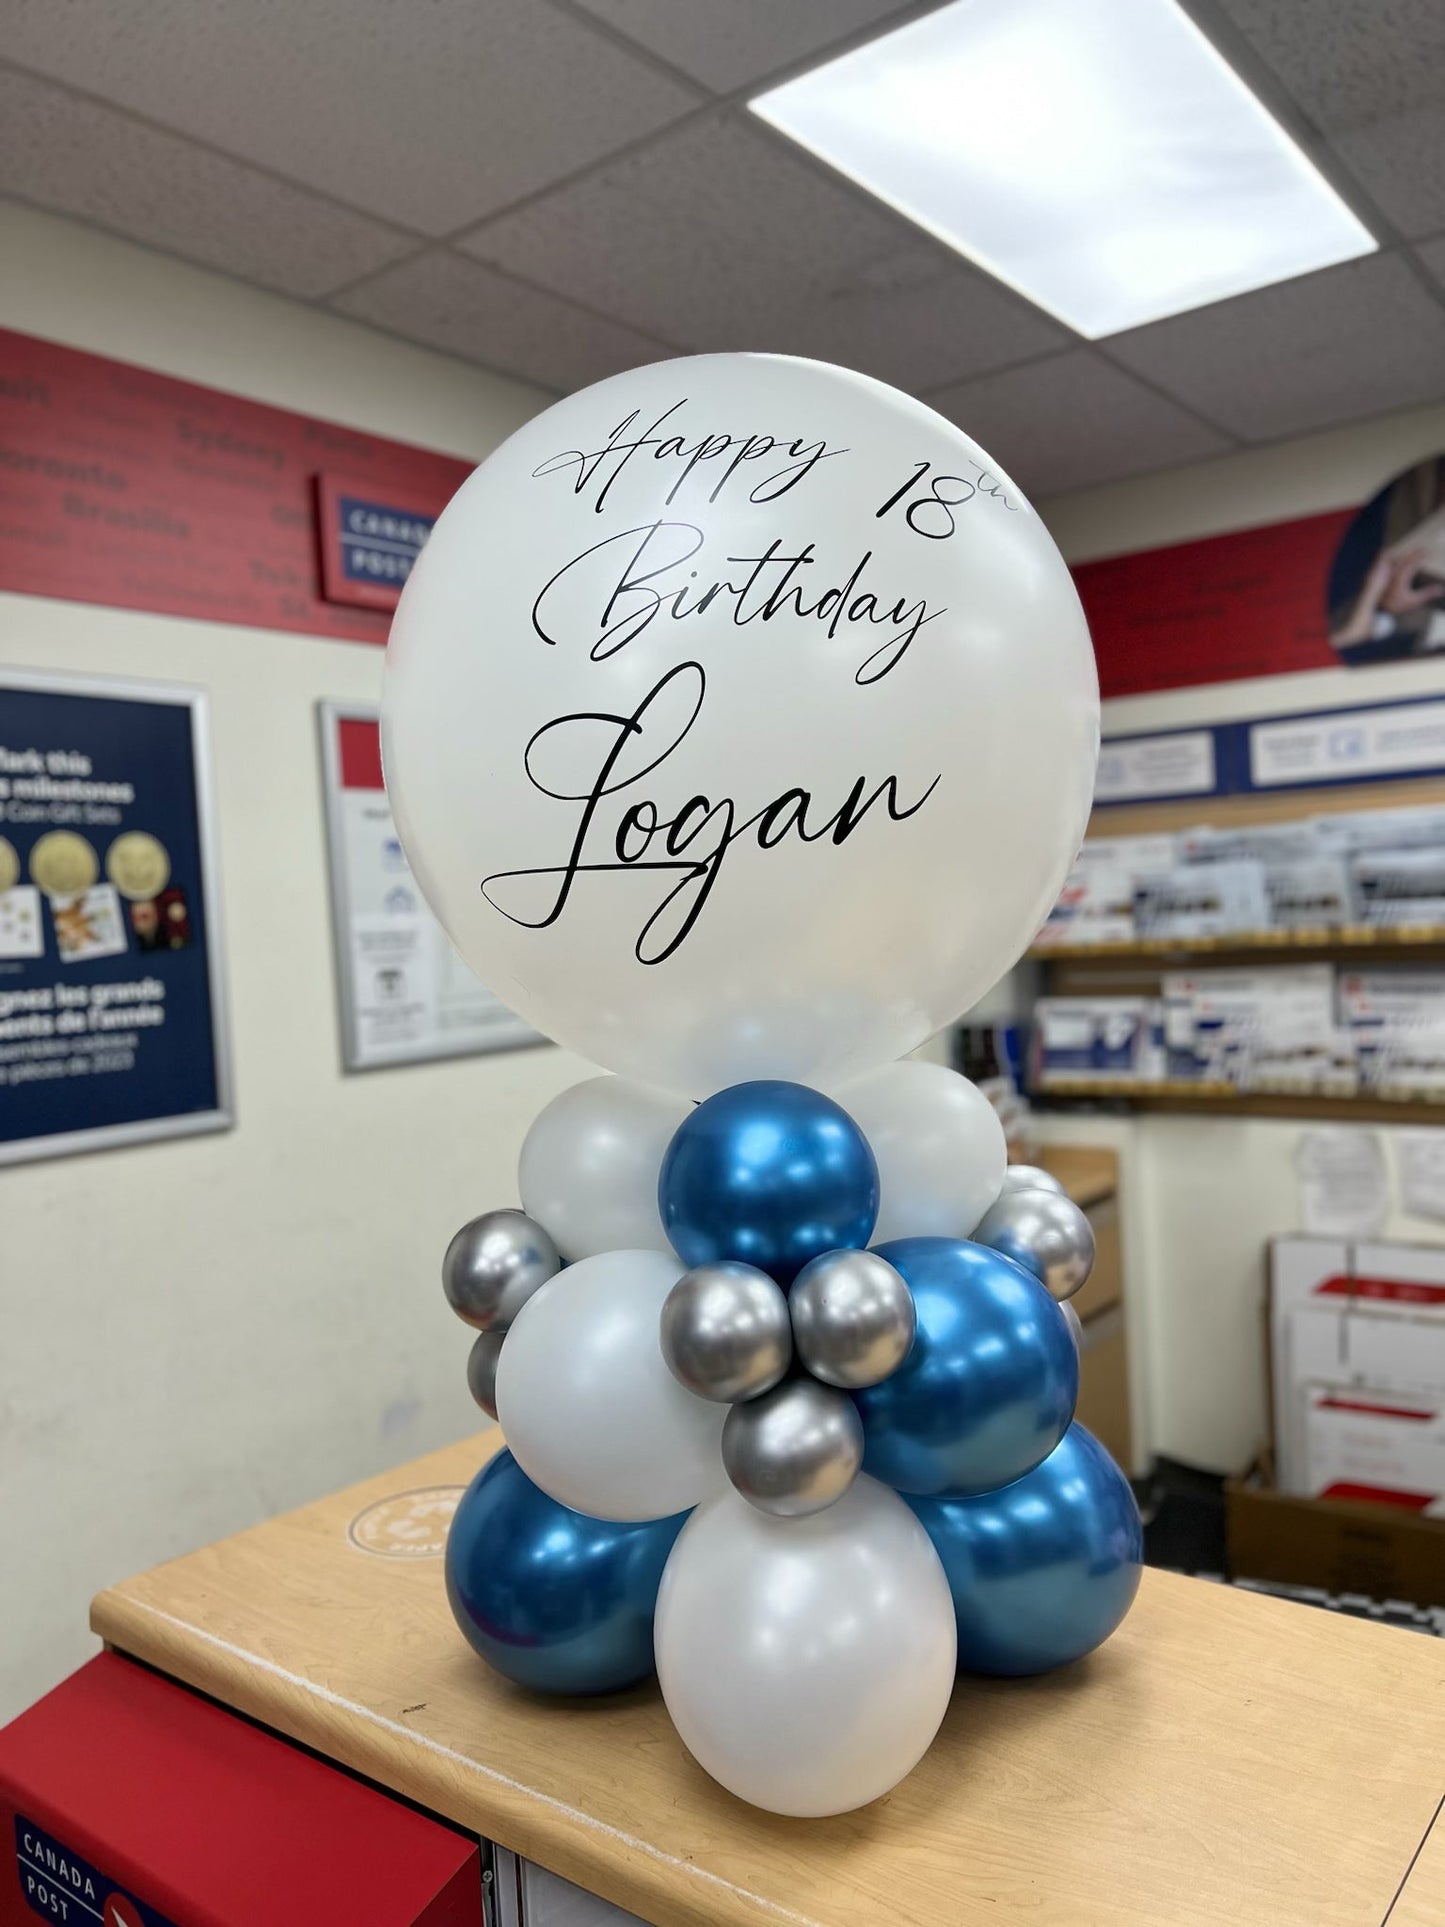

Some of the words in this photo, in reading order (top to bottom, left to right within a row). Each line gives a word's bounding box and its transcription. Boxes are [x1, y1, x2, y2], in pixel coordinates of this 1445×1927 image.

[0, 446, 129, 493] oronto
[532, 398, 851, 513] Happy
[348, 508, 431, 548] CANAD
[532, 519, 949, 685] Birthday
[46, 749, 93, 777] this
[12, 774, 136, 805] milestones
[480, 660, 943, 966] Logan
[54, 982, 88, 1008] les
[90, 976, 166, 1010] grands
[55, 1008, 87, 1034] de
[23, 1833, 96, 1900] CANADA
[27, 1875, 69, 1921] POST
